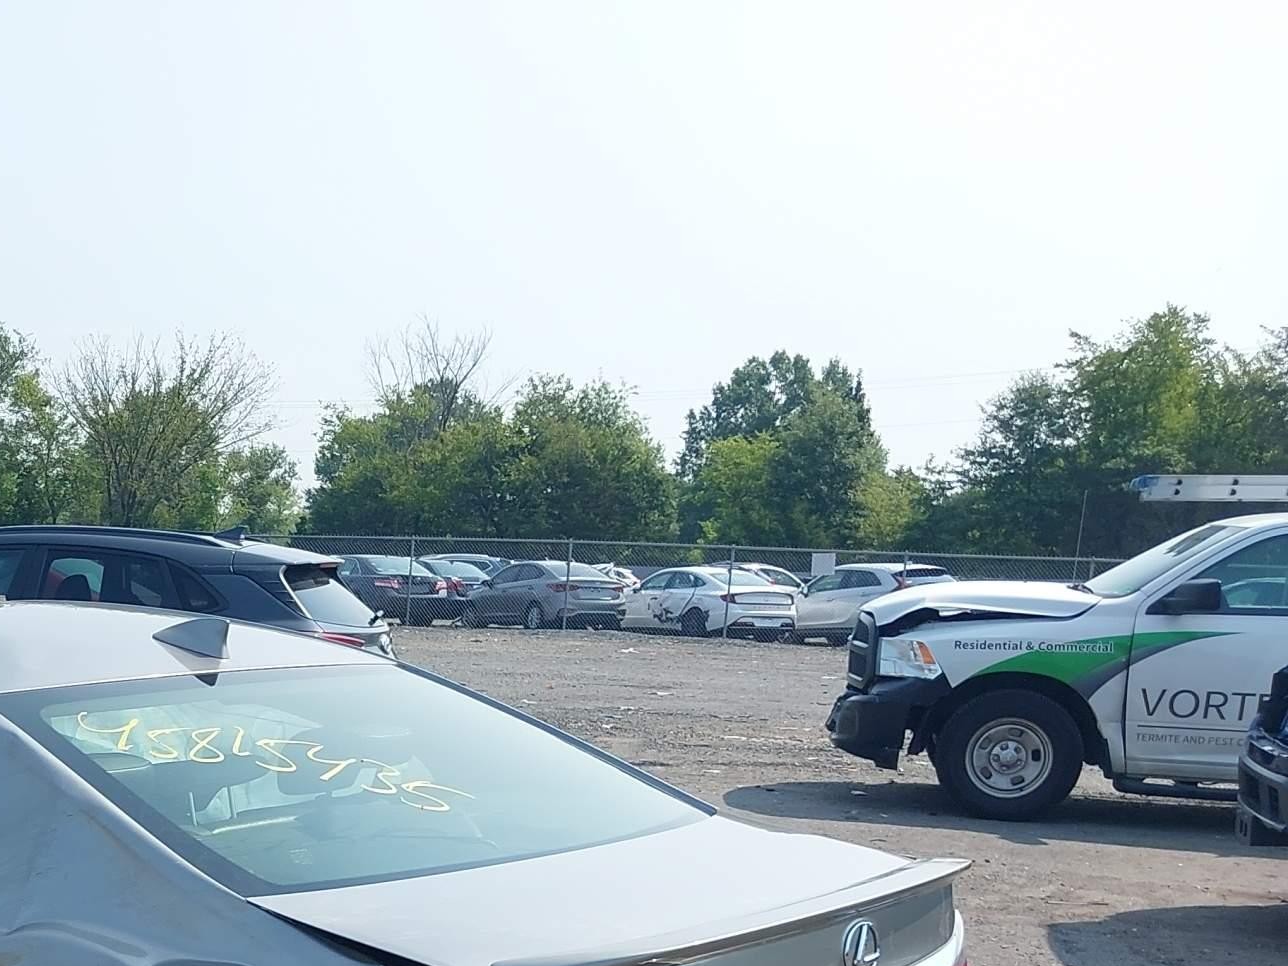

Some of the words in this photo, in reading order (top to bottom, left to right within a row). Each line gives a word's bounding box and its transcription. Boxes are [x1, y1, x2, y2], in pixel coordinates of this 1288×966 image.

[954, 640, 1023, 651] Residential
[1025, 641, 1035, 651] &
[1038, 641, 1114, 653] Commercial
[1136, 732, 1180, 744] TERMITE
[1182, 735, 1206, 746] AND
[1208, 736, 1234, 747] PEST
